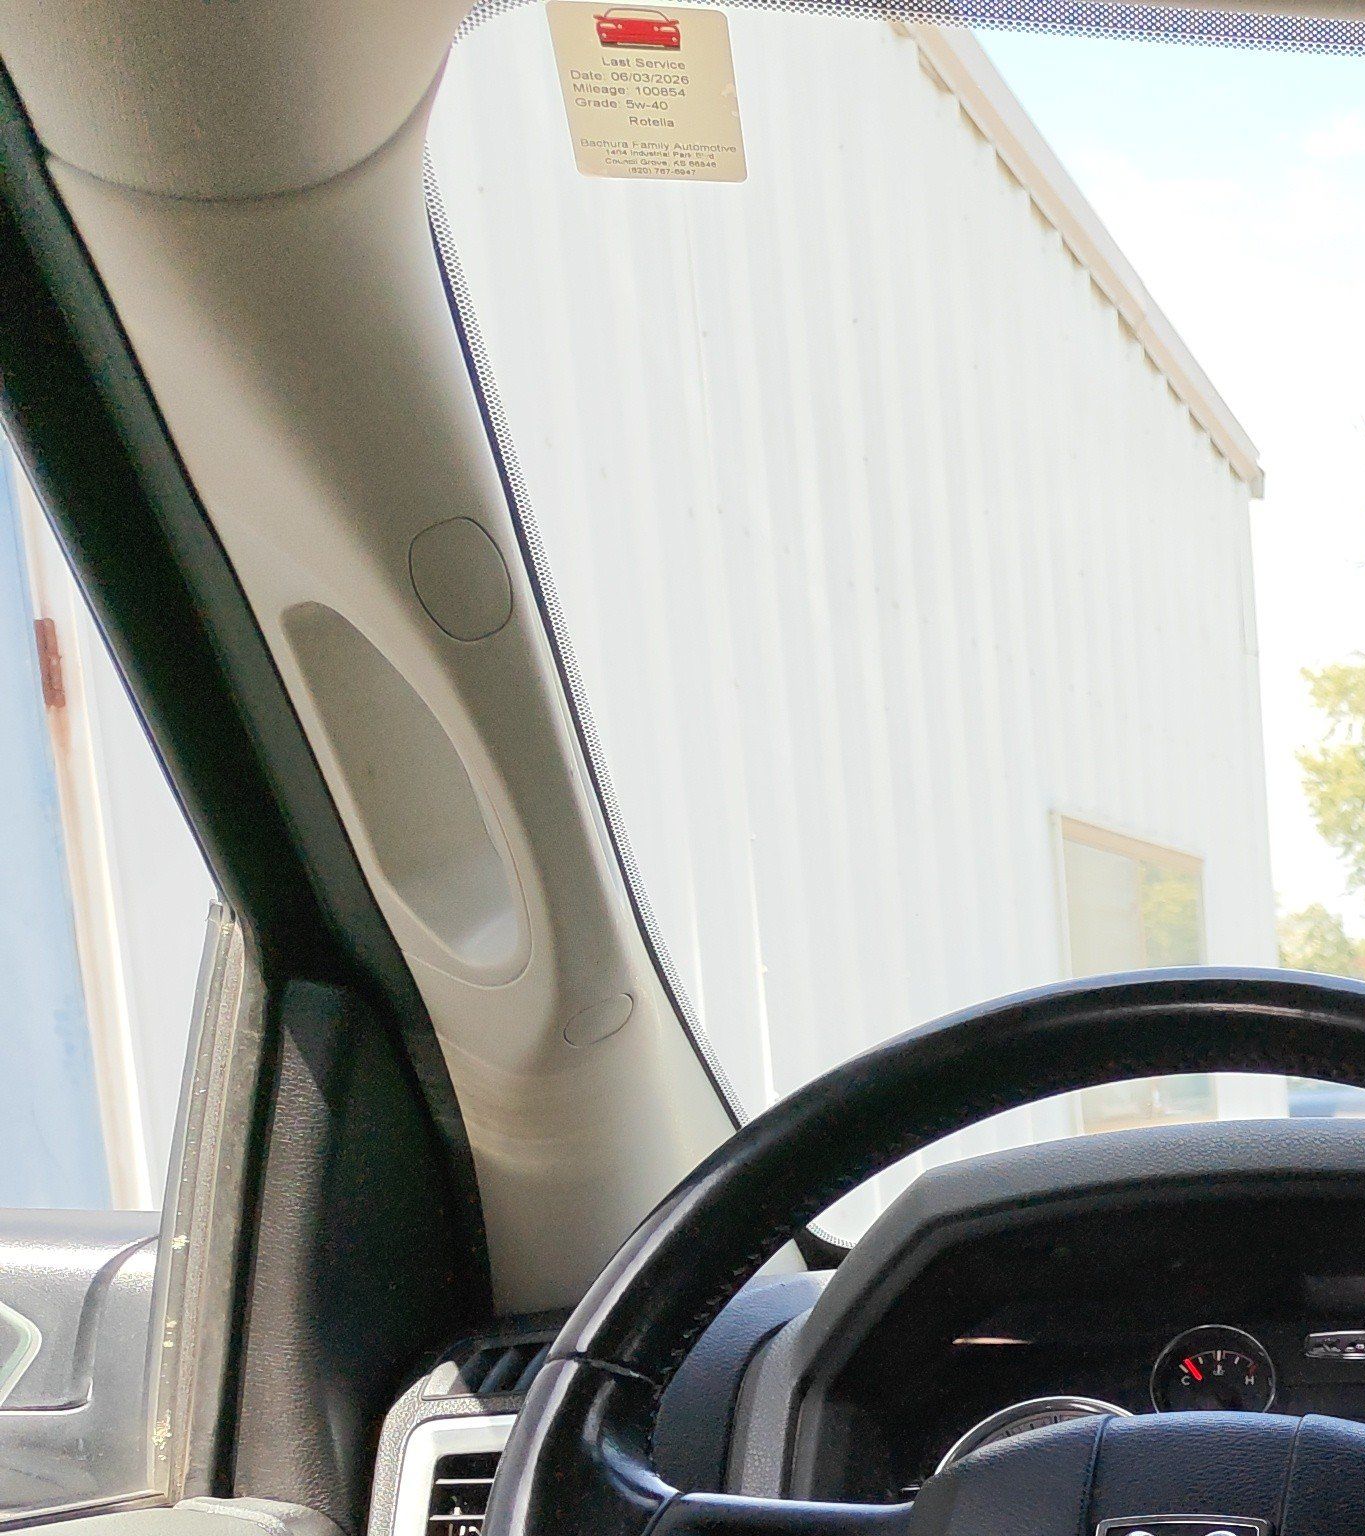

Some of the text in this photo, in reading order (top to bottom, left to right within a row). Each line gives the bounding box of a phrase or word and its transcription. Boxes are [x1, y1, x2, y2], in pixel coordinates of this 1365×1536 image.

[602, 57, 686, 70] Last Service
[610, 71, 690, 85] 06/03/2026
[635, 86, 686, 97] 100854
[625, 99, 669, 110] 5w-40
[629, 116, 675, 128] Rotella
